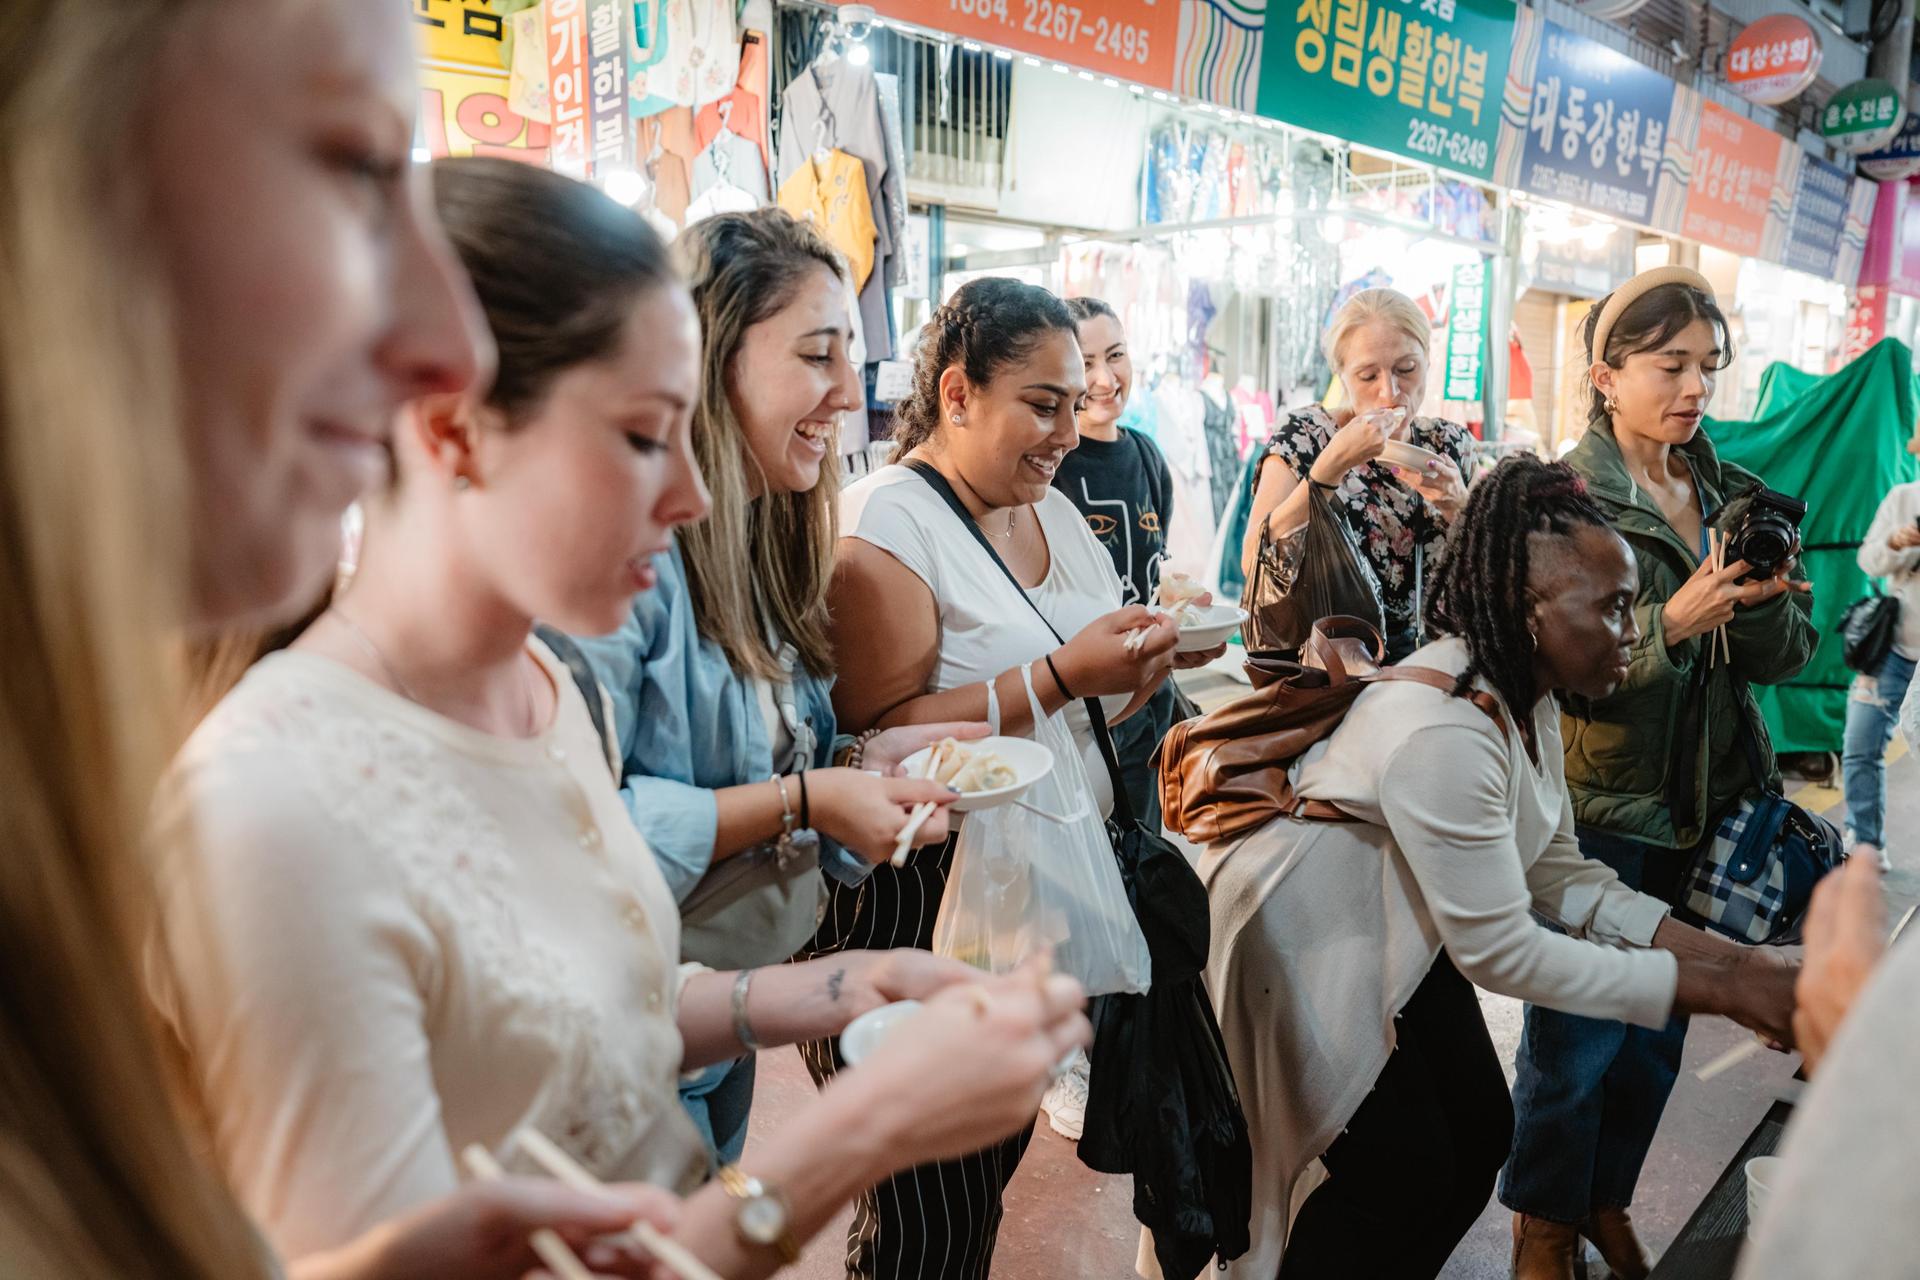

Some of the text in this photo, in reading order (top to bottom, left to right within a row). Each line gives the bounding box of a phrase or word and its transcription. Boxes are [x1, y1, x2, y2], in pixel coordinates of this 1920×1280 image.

[1022, 0, 1150, 65] 2267-2495
[1406, 117, 1488, 170] 2267-6249
[1530, 75, 1663, 188] 대동강한복
